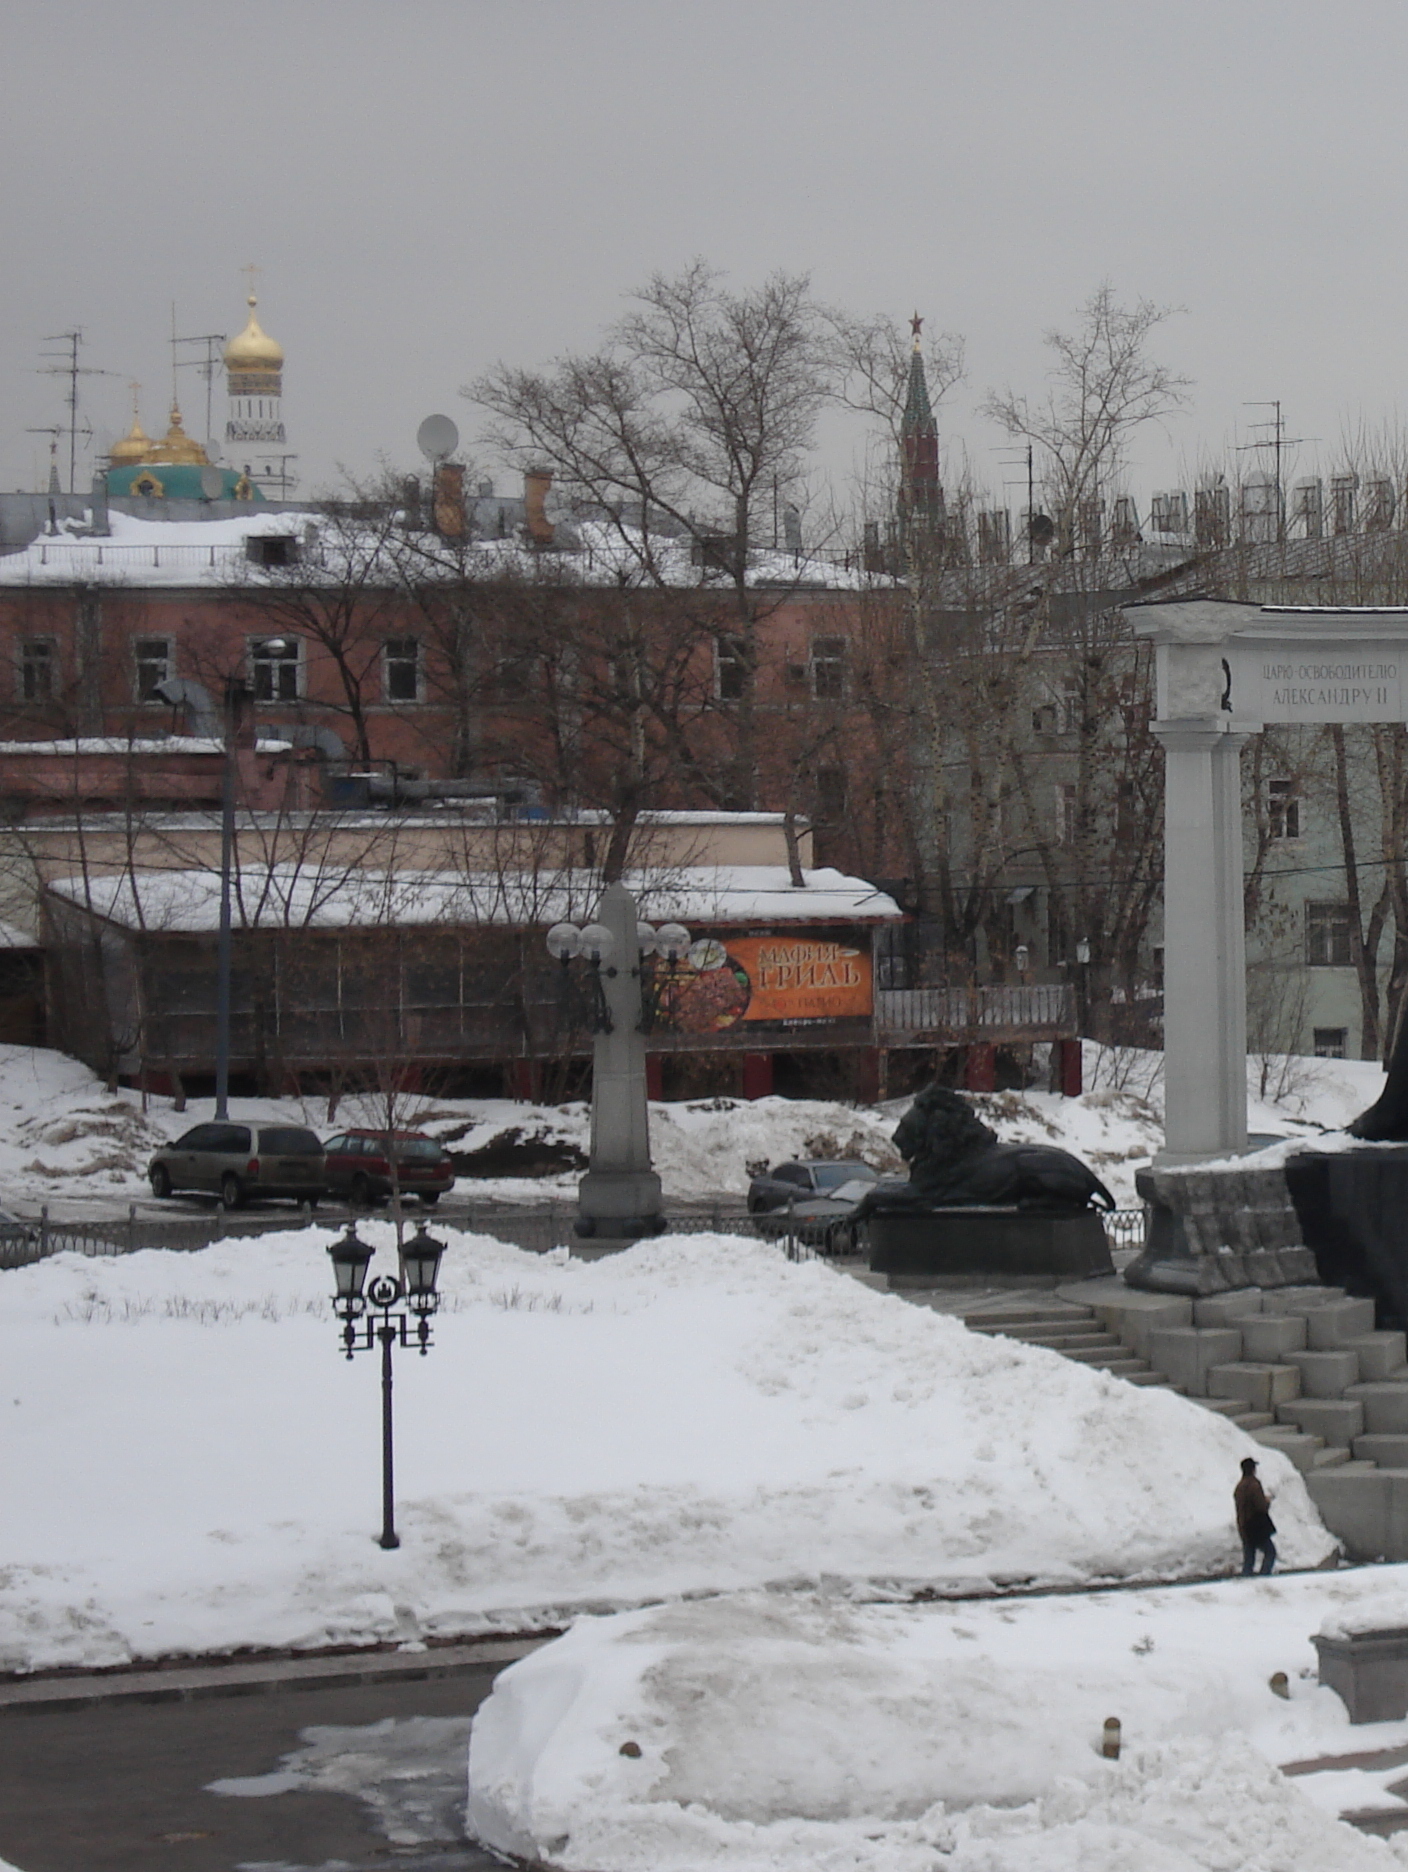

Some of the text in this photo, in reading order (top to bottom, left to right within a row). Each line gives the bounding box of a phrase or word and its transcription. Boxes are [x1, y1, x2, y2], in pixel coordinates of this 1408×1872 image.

[1273, 687, 1388, 706] АЛЕКСАНДРУ II
[760, 962, 861, 990] ГРИЛЬ
